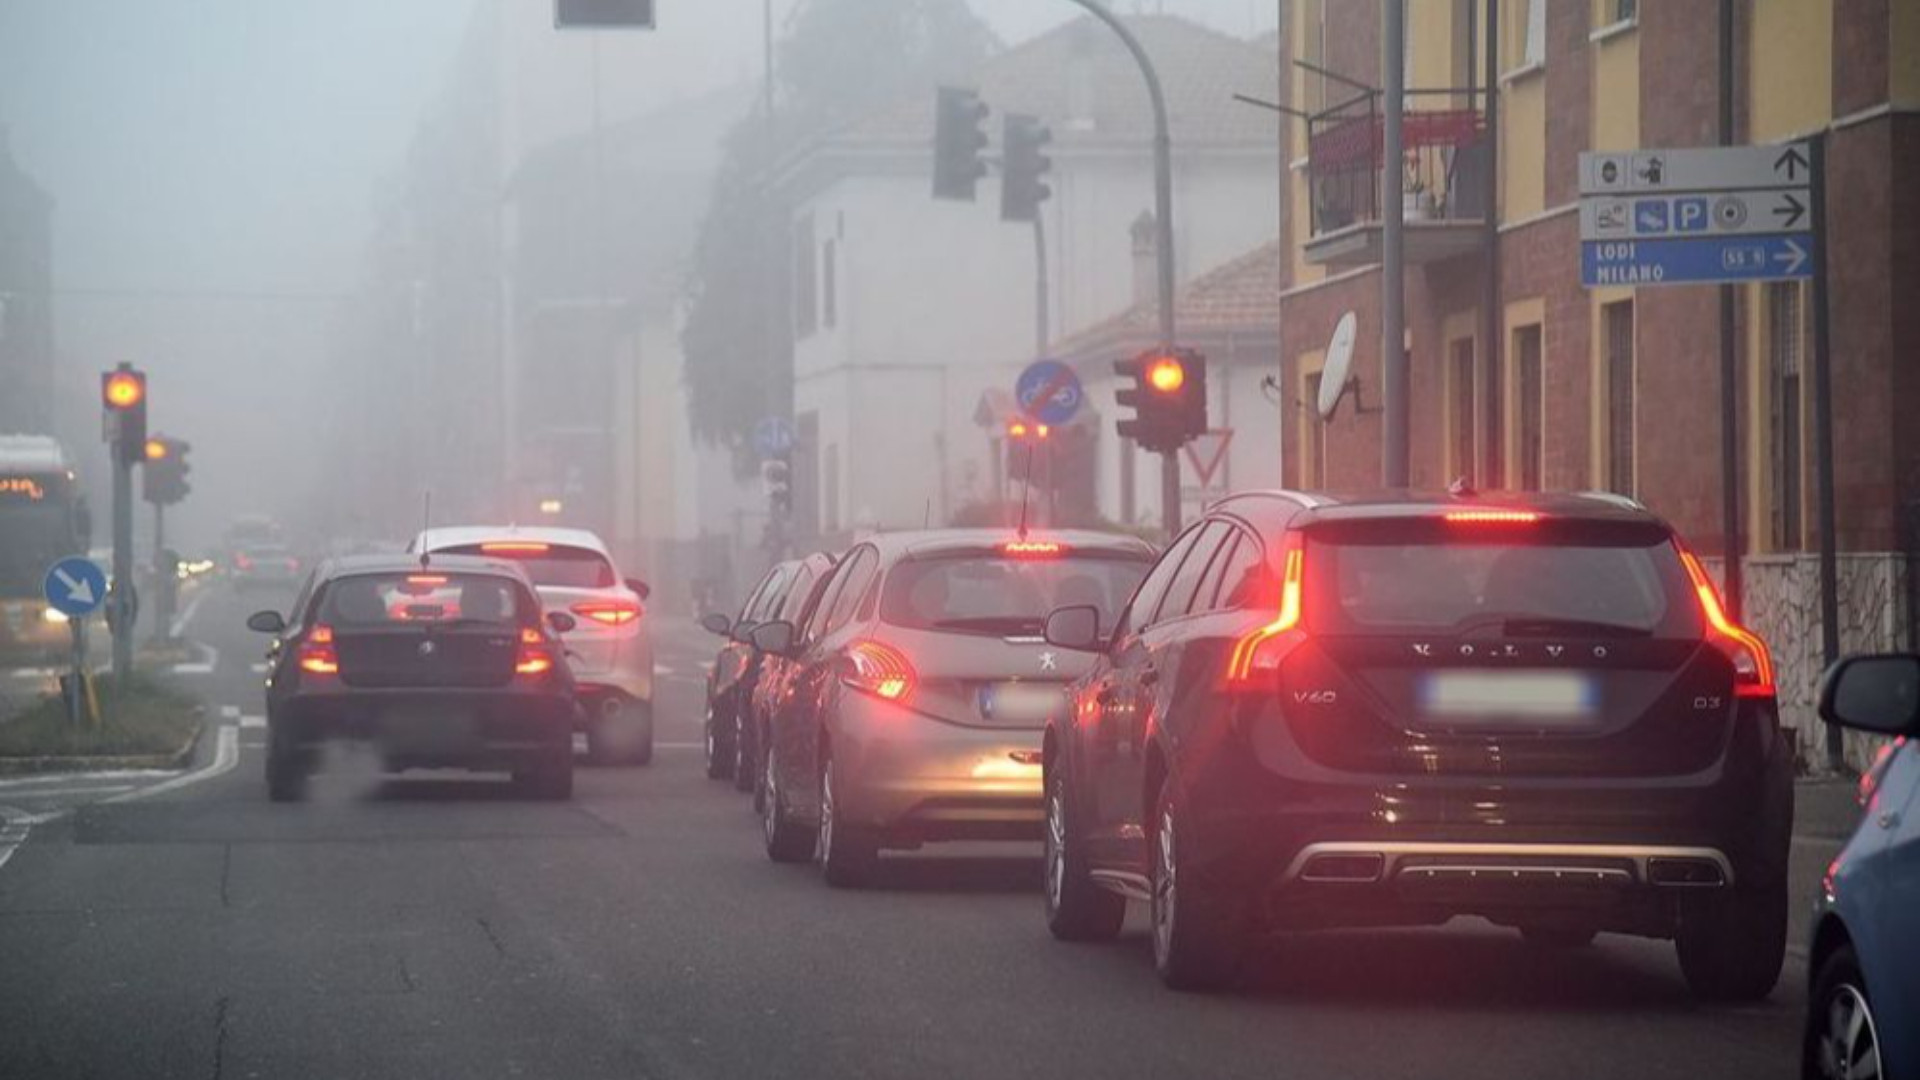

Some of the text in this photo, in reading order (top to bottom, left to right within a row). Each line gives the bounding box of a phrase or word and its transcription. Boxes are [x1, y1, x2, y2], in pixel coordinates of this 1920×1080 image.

[1681, 204, 1699, 228] P
[1596, 242, 1635, 261] LODI
[1726, 250, 1744, 265] SS
[1597, 263, 1663, 283] MILANO
[1413, 643, 1607, 657] VOLVO
[1294, 689, 1337, 704] V60
[1693, 696, 1721, 709] D3
